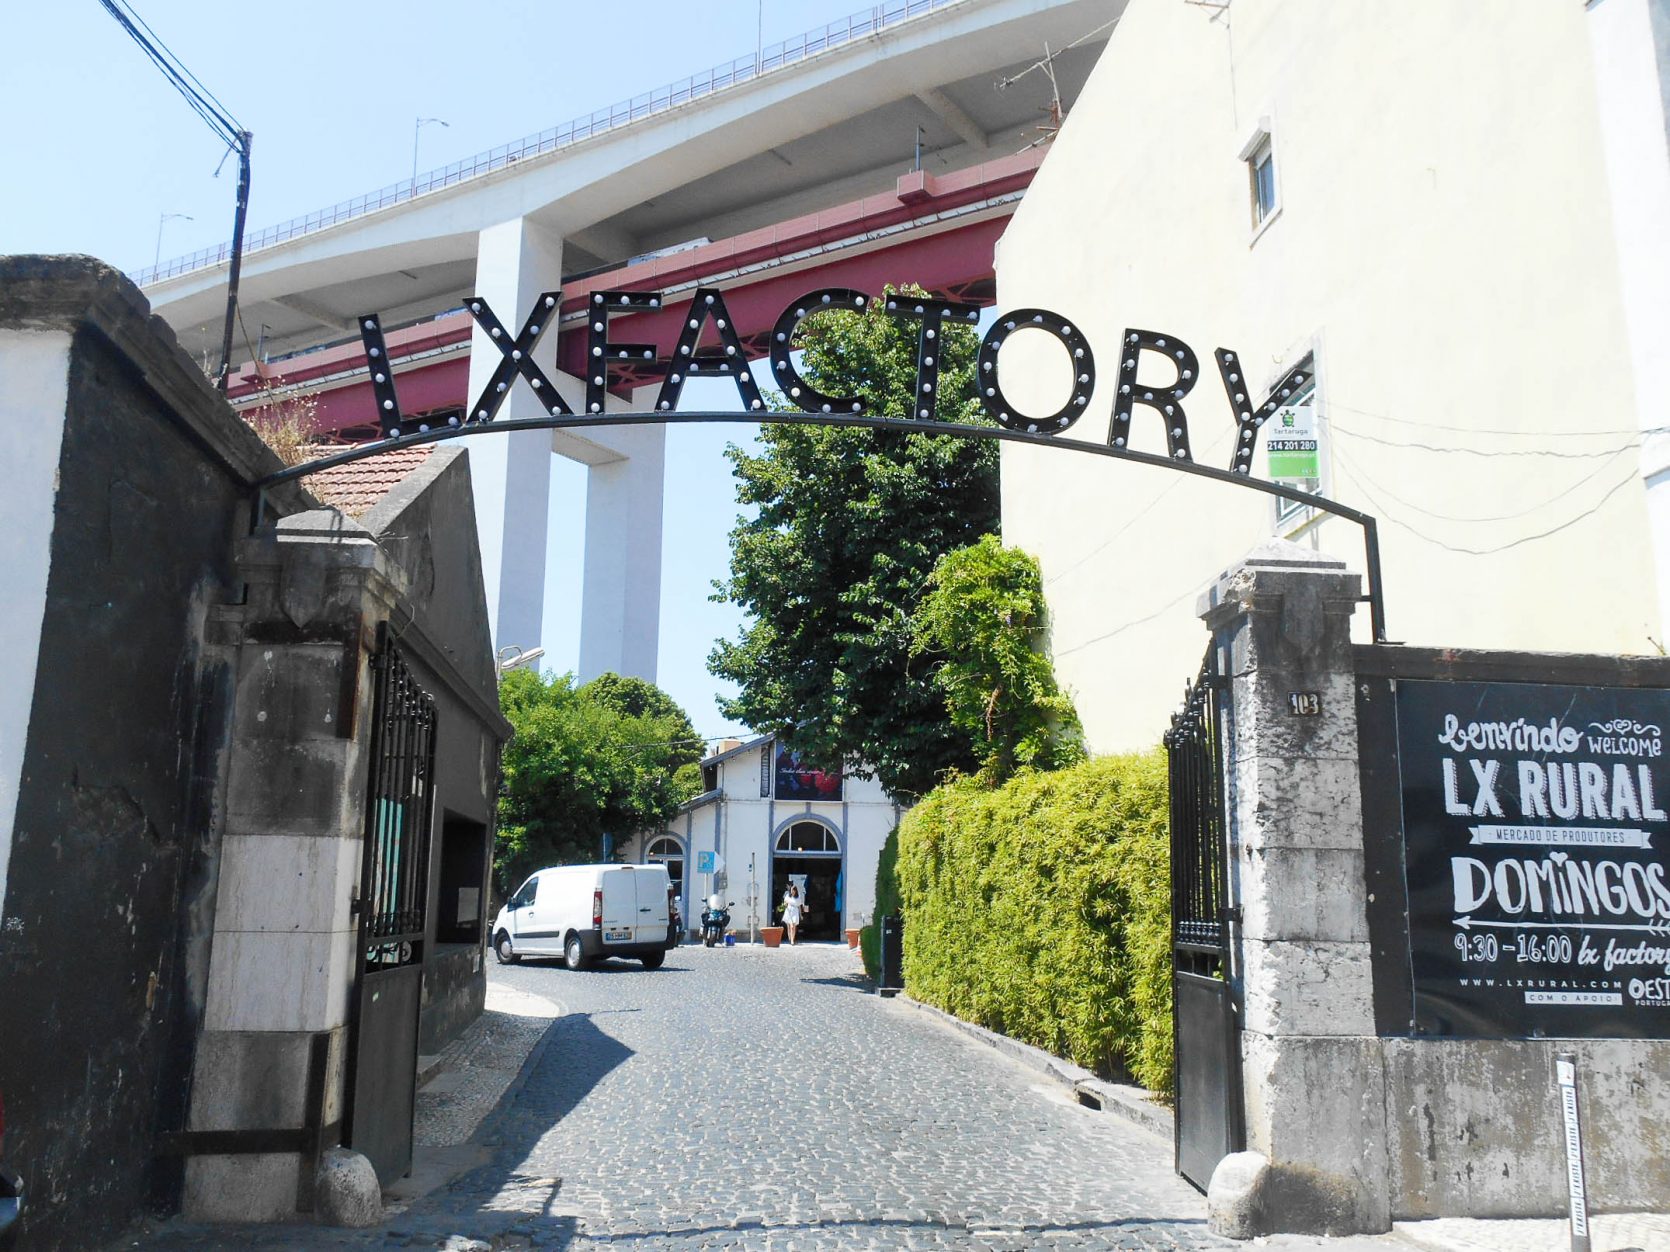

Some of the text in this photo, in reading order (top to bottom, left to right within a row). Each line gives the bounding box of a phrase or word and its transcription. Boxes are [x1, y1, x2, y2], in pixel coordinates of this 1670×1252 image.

[1268, 441, 1315, 450] 214 201 280
[1291, 694, 1319, 715] 103
[1443, 758, 1668, 822] LX RURAL
[1496, 829, 1624, 843] MERCADO DE PRODUTORES
[1460, 978, 1621, 989] WWW.LXRURAL.COM
[1529, 994, 1554, 1002] COM
[1561, 994, 1568, 1002] O
